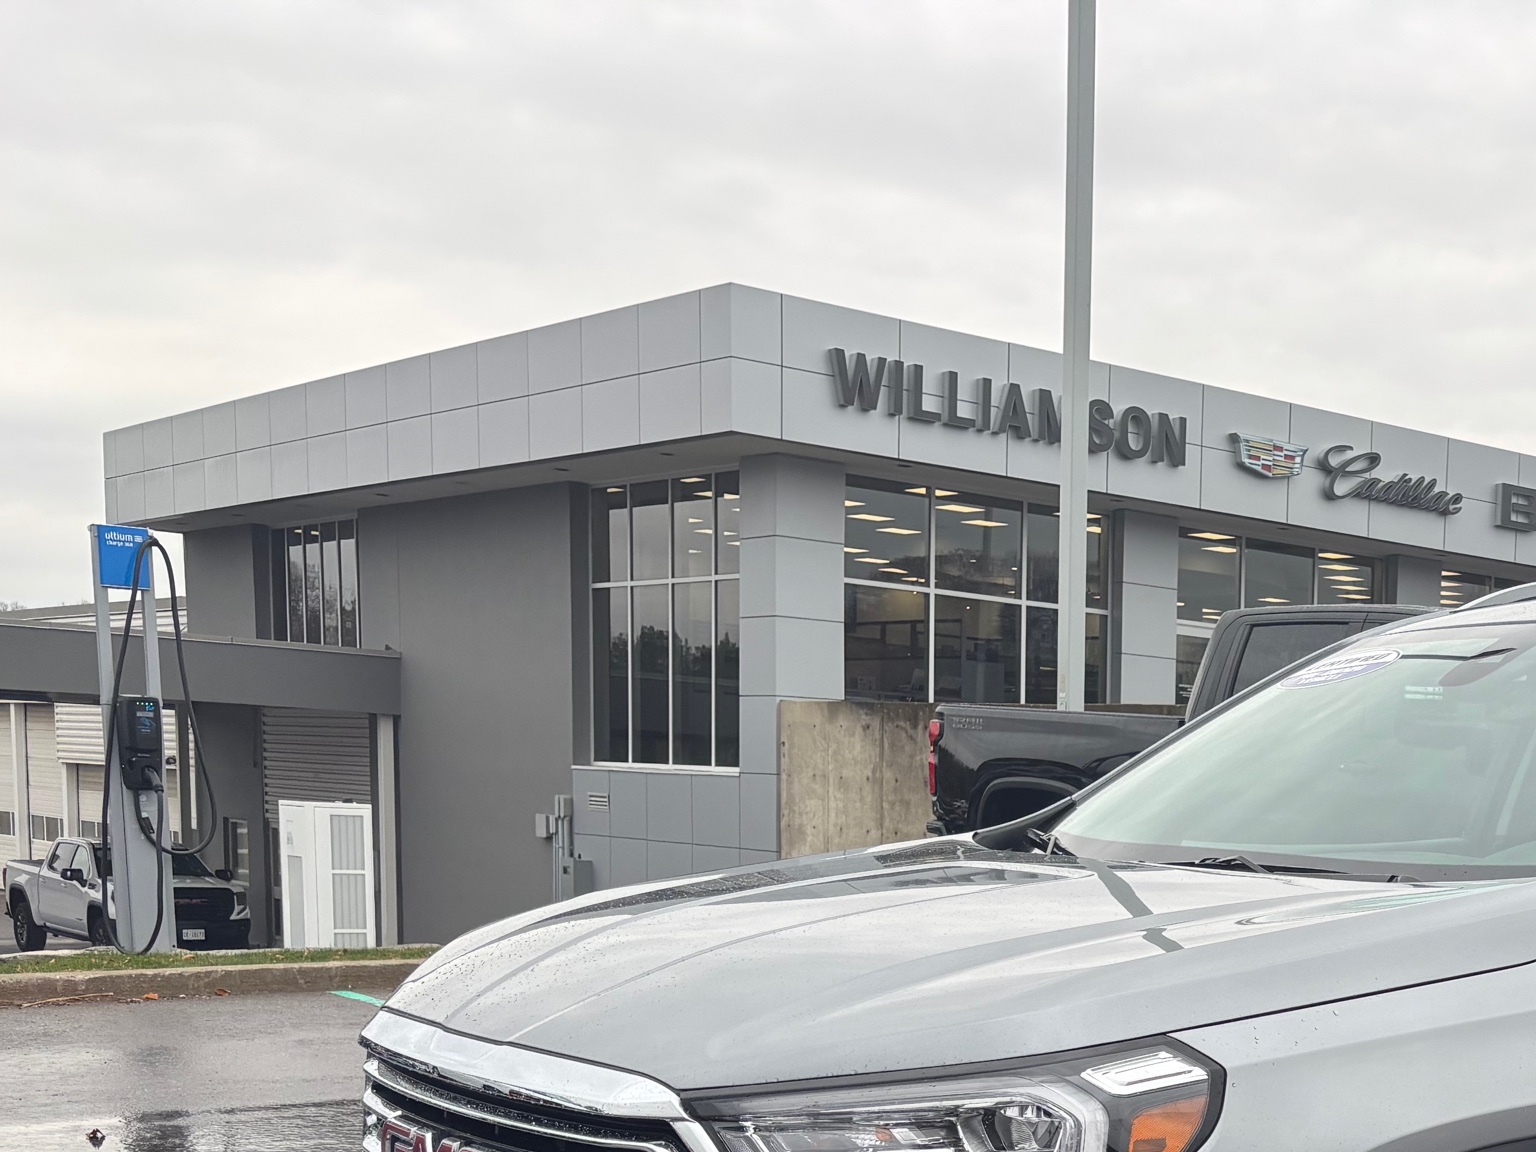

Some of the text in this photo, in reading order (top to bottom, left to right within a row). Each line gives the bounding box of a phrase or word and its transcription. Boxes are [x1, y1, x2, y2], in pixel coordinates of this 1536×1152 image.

[828, 347, 1187, 467] WILLIAMSON
[1317, 444, 1464, 516] Cadillac
[104, 531, 134, 542] ultium
